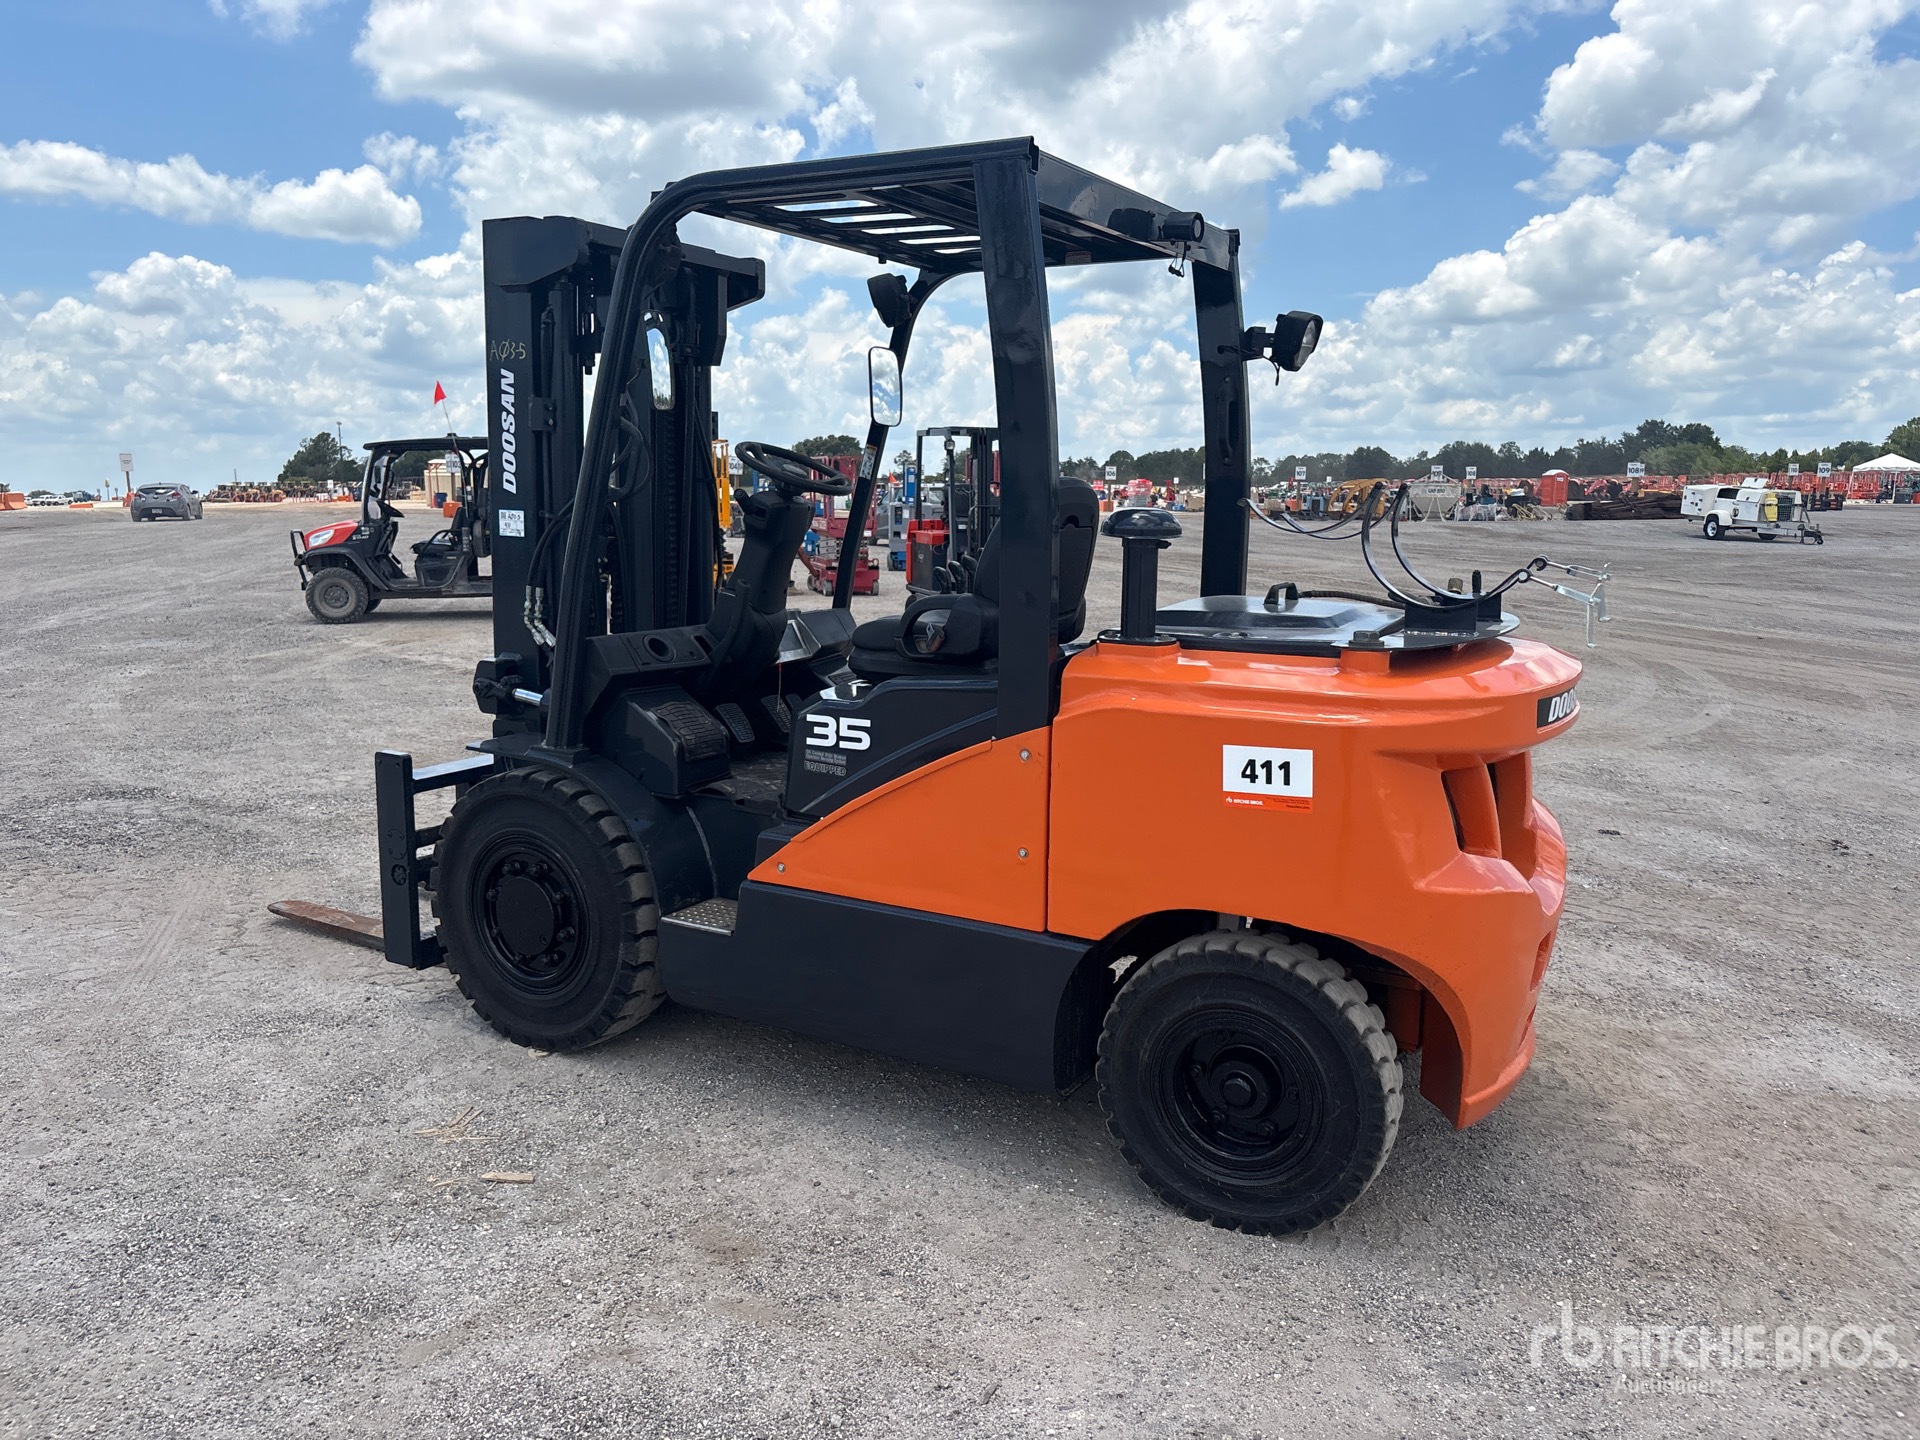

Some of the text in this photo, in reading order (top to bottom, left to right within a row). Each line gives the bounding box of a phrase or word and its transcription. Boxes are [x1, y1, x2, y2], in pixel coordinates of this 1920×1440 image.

[500, 368, 517, 494] DOOSAN
[1548, 688, 1576, 723] DOO
[806, 713, 871, 751] 35
[1241, 758, 1291, 786] 411
